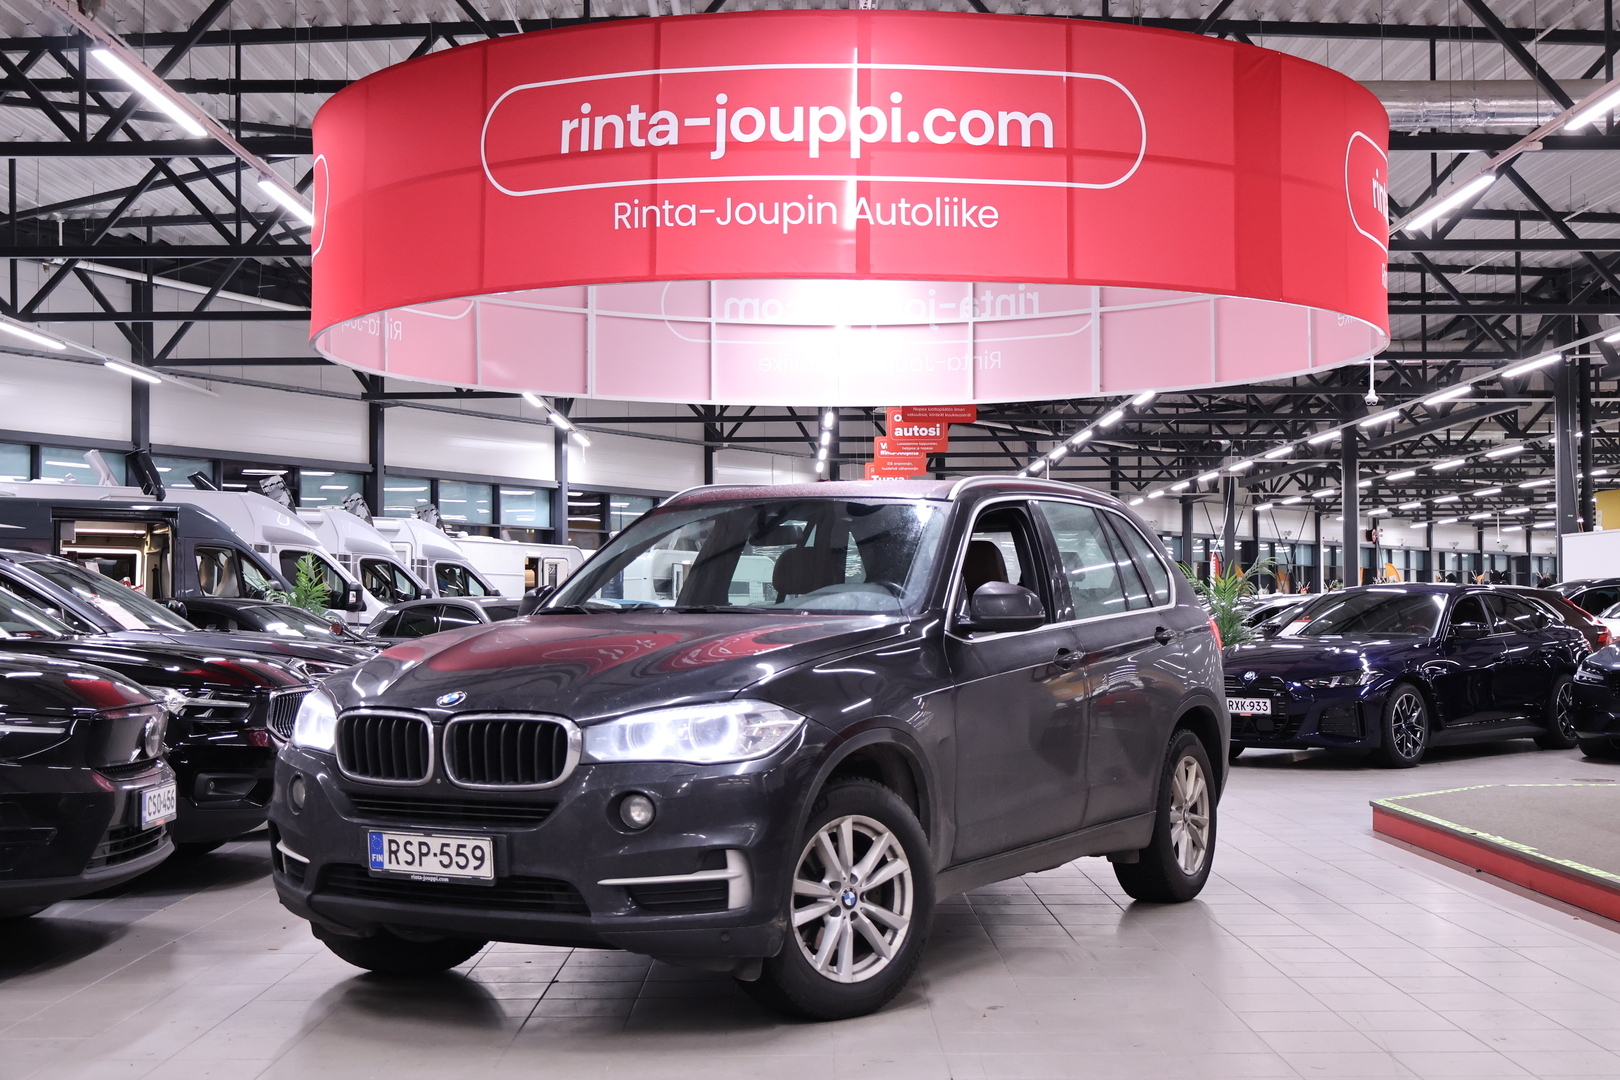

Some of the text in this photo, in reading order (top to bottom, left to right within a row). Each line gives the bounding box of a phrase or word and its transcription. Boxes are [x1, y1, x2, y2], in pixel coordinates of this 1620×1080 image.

[560, 91, 1054, 160] rinta-jouppi.com
[614, 194, 999, 234] Rinta-Joupin Autoliike
[894, 424, 941, 436] autosi
[1228, 700, 1268, 712] RXK-933
[372, 853, 383, 862] FIN
[388, 839, 486, 871] RSP-559
[410, 874, 450, 883] rinta-jouppi.com
